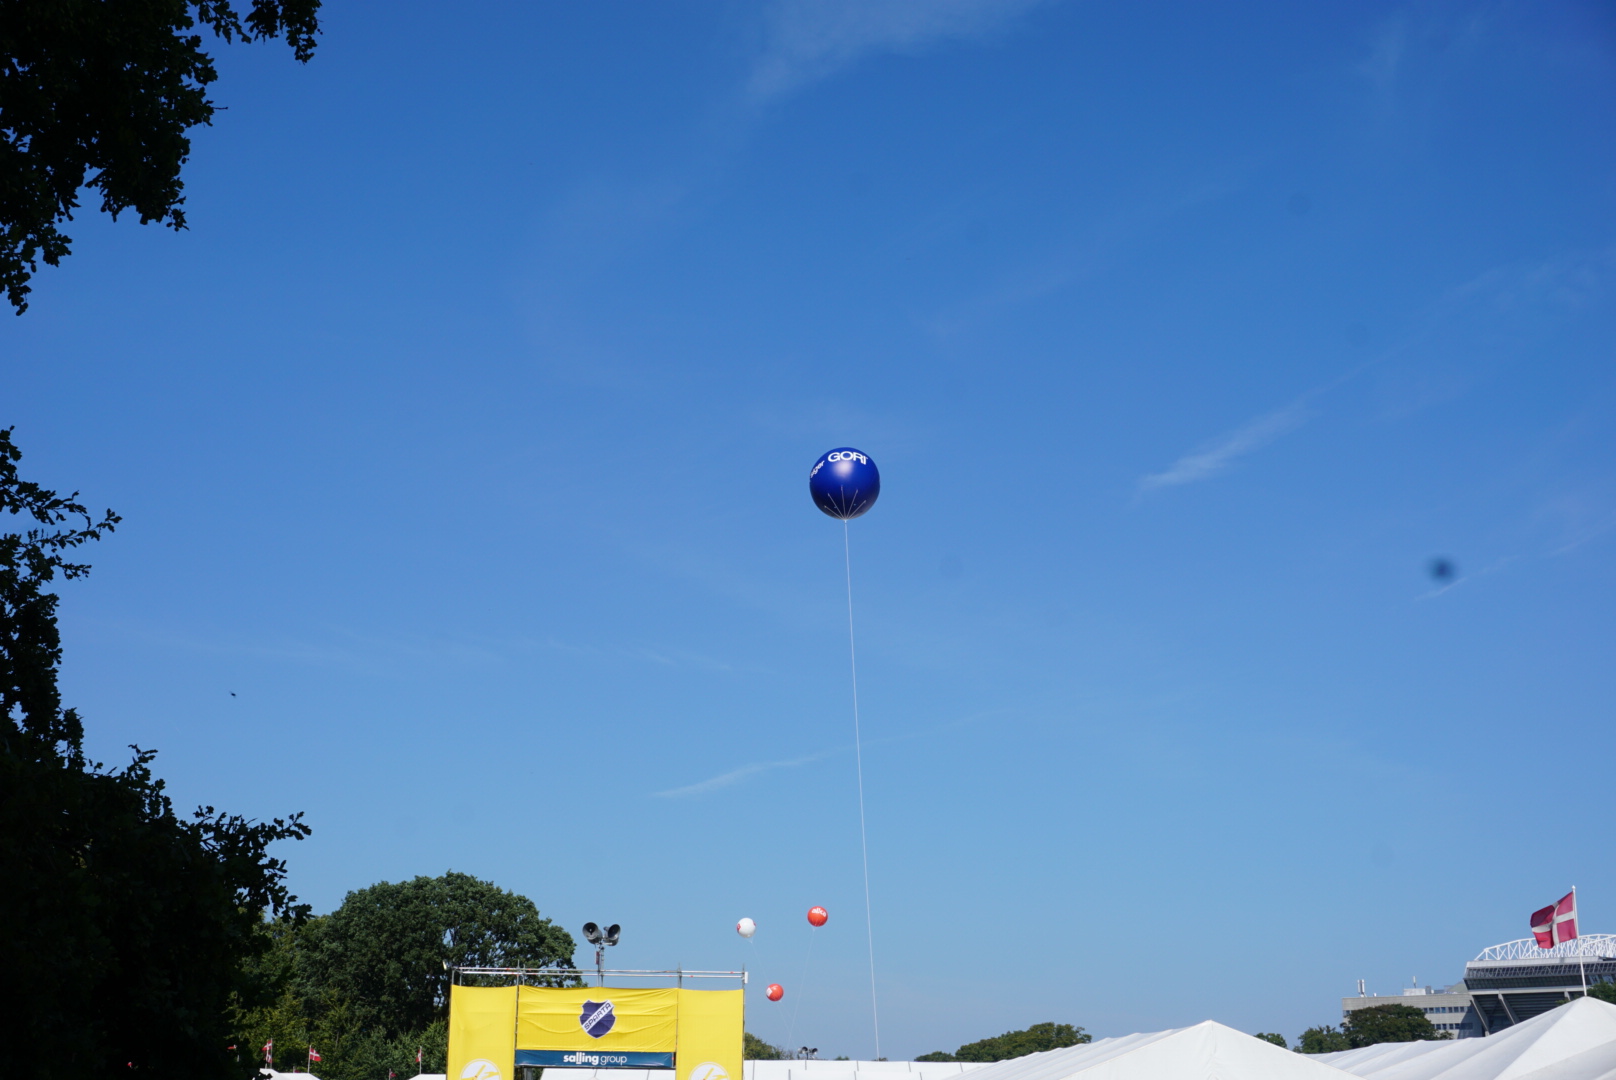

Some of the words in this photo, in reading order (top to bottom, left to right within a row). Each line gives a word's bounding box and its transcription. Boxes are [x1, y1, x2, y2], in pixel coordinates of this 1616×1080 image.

[828, 451, 867, 465] GORI
[584, 1002, 611, 1030] SPARTA
[563, 1052, 599, 1065] salling
[600, 1056, 627, 1066] group
